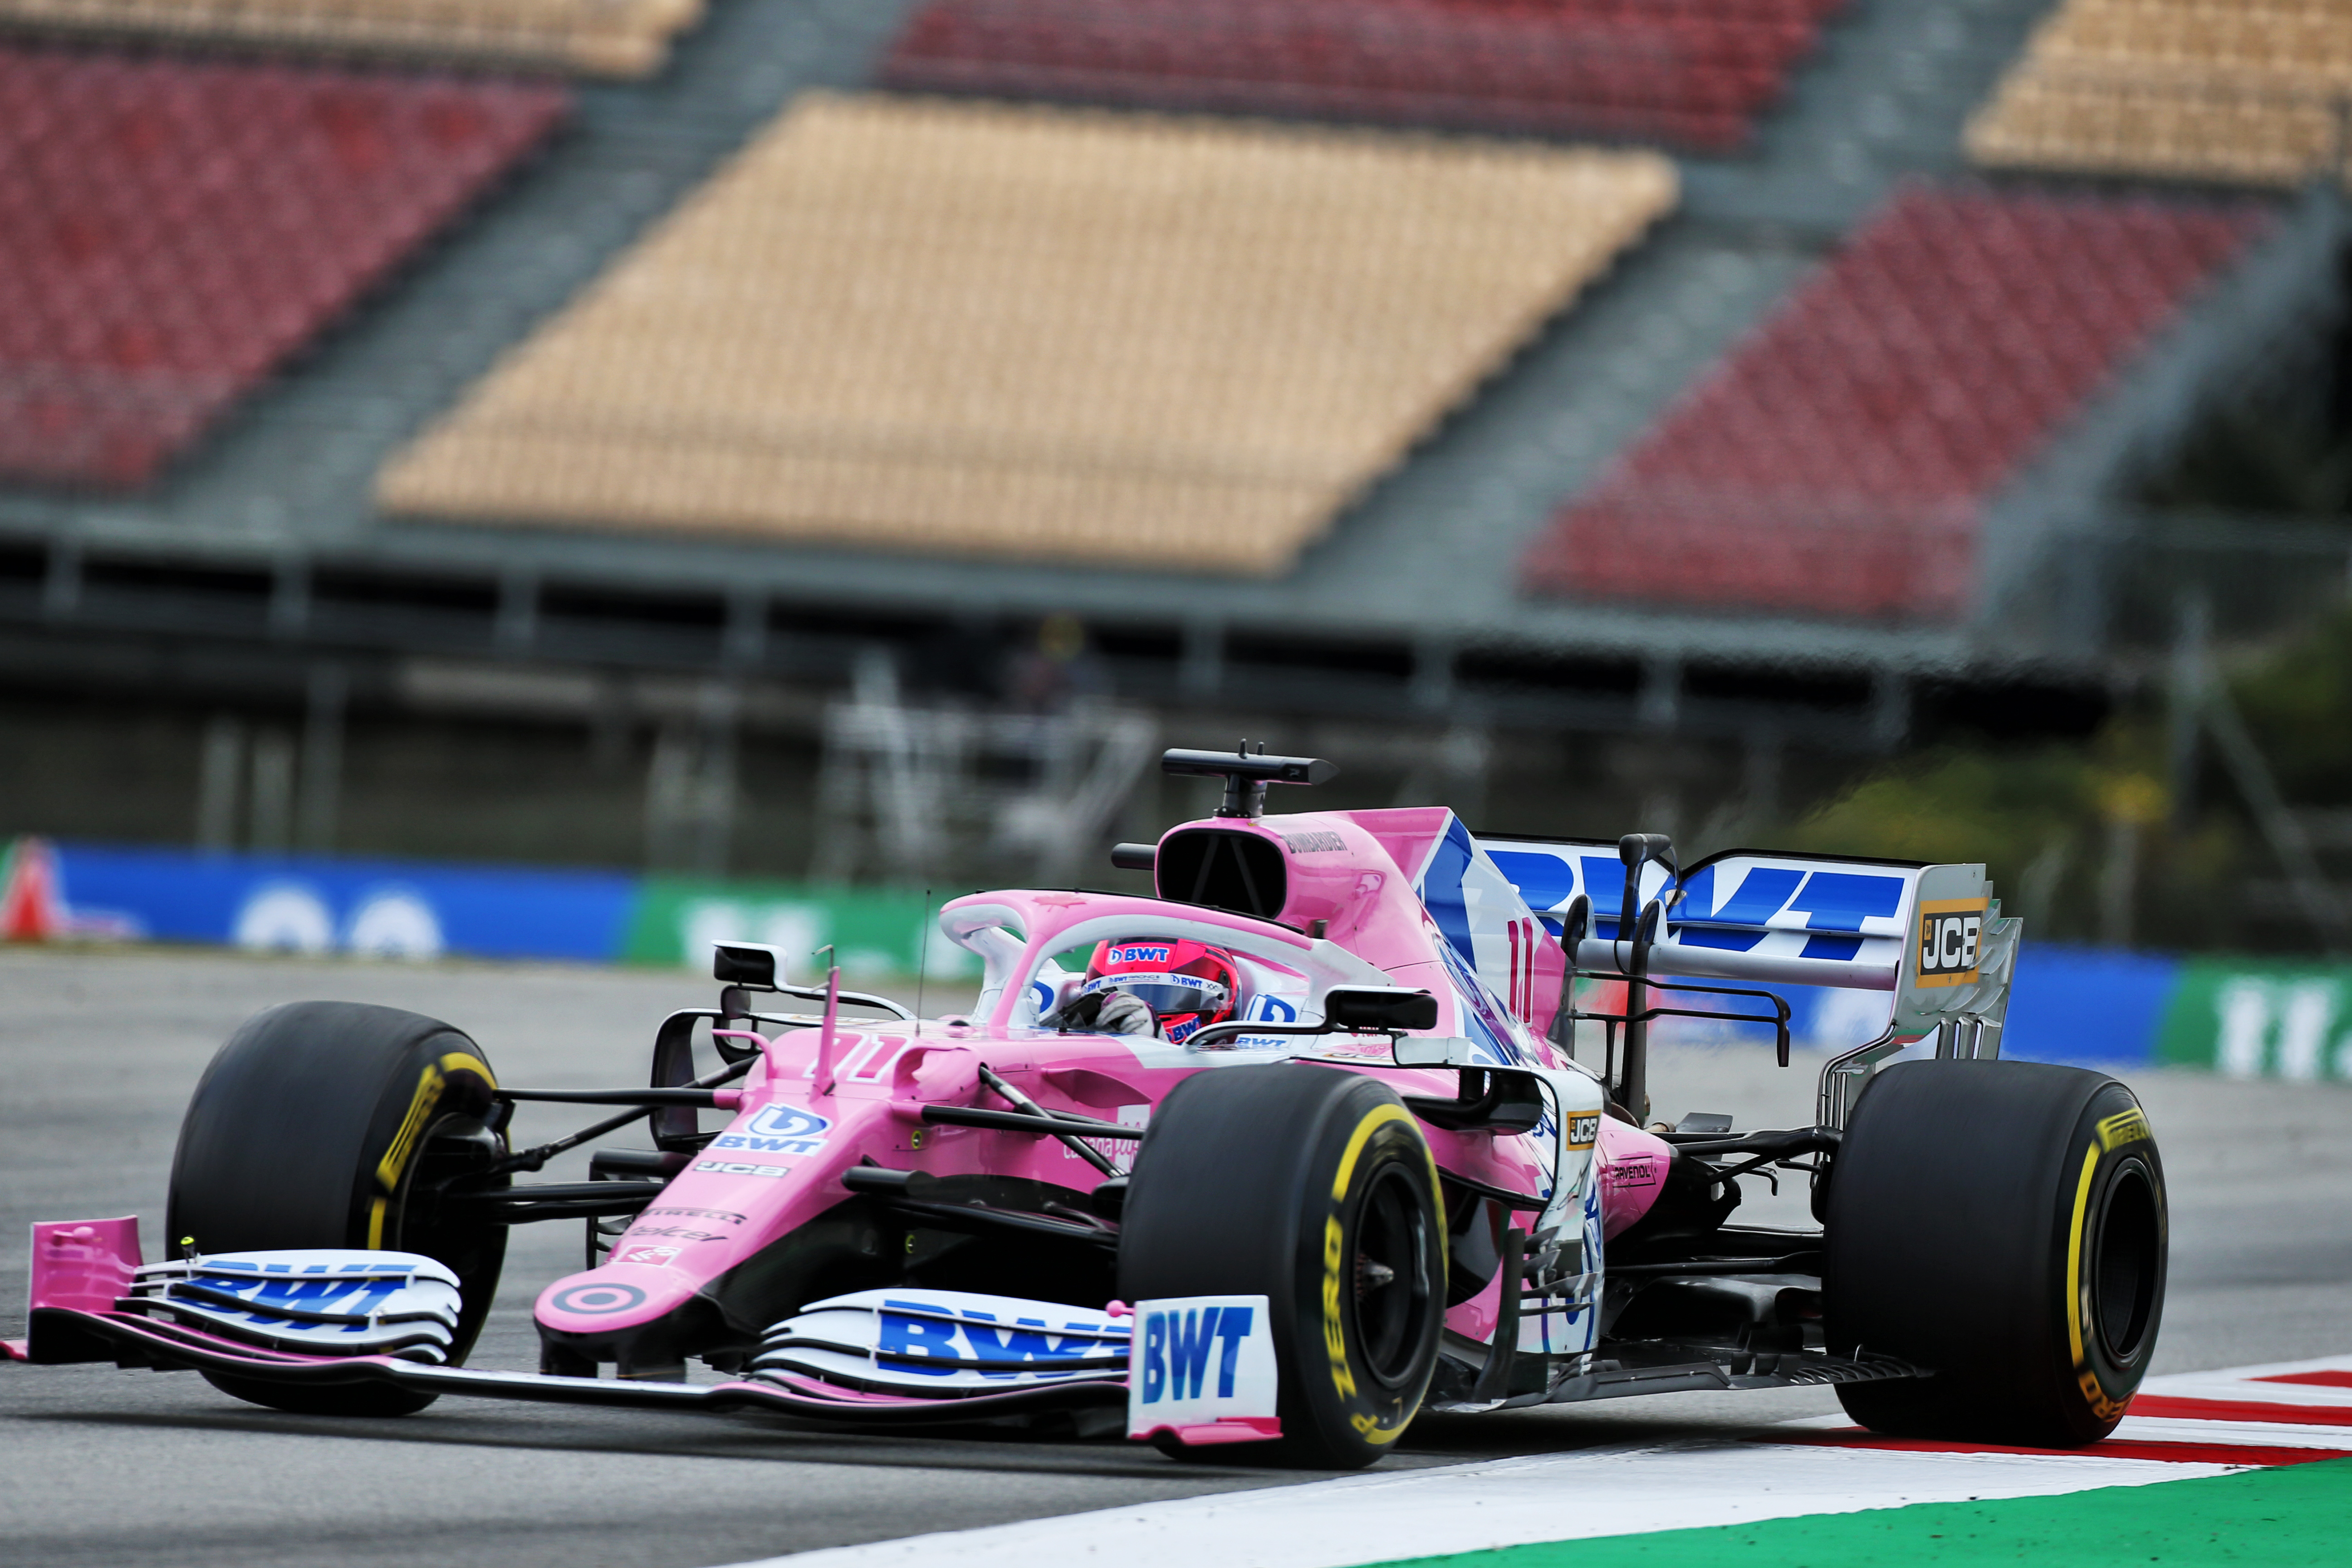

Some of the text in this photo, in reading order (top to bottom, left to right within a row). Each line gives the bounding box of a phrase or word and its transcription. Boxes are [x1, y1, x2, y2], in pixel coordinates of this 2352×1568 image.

[1279, 831, 1348, 854] BOMBARDIER
[1923, 916, 1981, 969] JCB
[1124, 947, 1169, 962] BWT
[1181, 977, 1202, 989] BWT
[1507, 916, 1534, 1029] 11
[1235, 1037, 1287, 1047] BWT
[802, 1030, 914, 1083] 11
[1571, 1118, 1598, 1143] JCB
[714, 1135, 820, 1153] BWT
[693, 1161, 790, 1178] JCB
[1614, 1165, 1652, 1180] RAVENOL
[640, 1206, 747, 1225] PIRELLI
[168, 1261, 418, 1333] BWT
[1323, 1212, 1357, 1402] ZERO
[1142, 1307, 1253, 1404] BWT
